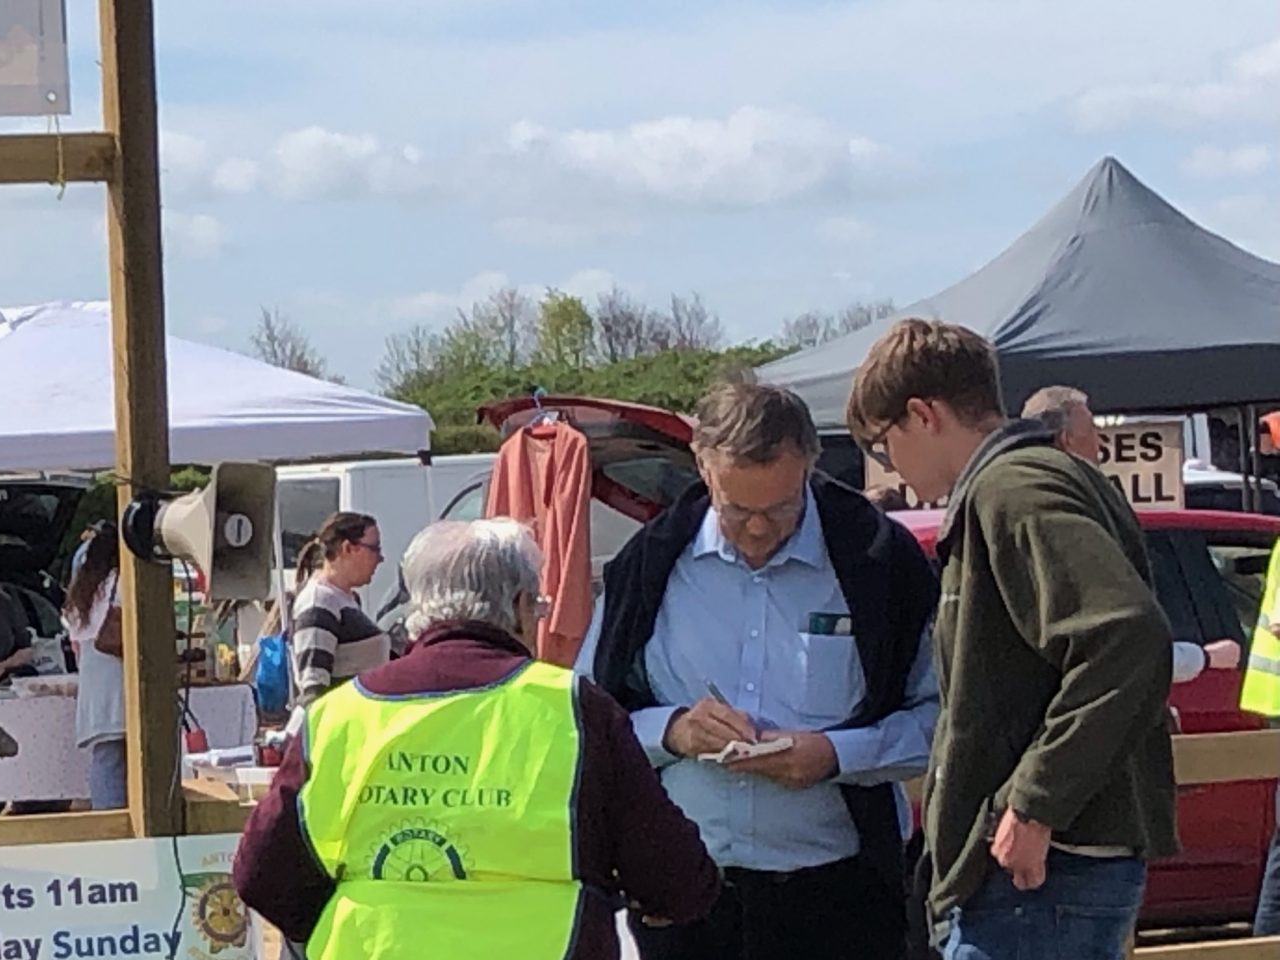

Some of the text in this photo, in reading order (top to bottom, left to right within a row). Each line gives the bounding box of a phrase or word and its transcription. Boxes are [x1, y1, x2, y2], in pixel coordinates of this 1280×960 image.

[358, 784, 513, 807] OTARY CLUB
[46, 877, 139, 907] 11am
[52, 924, 182, 960] Sunday
